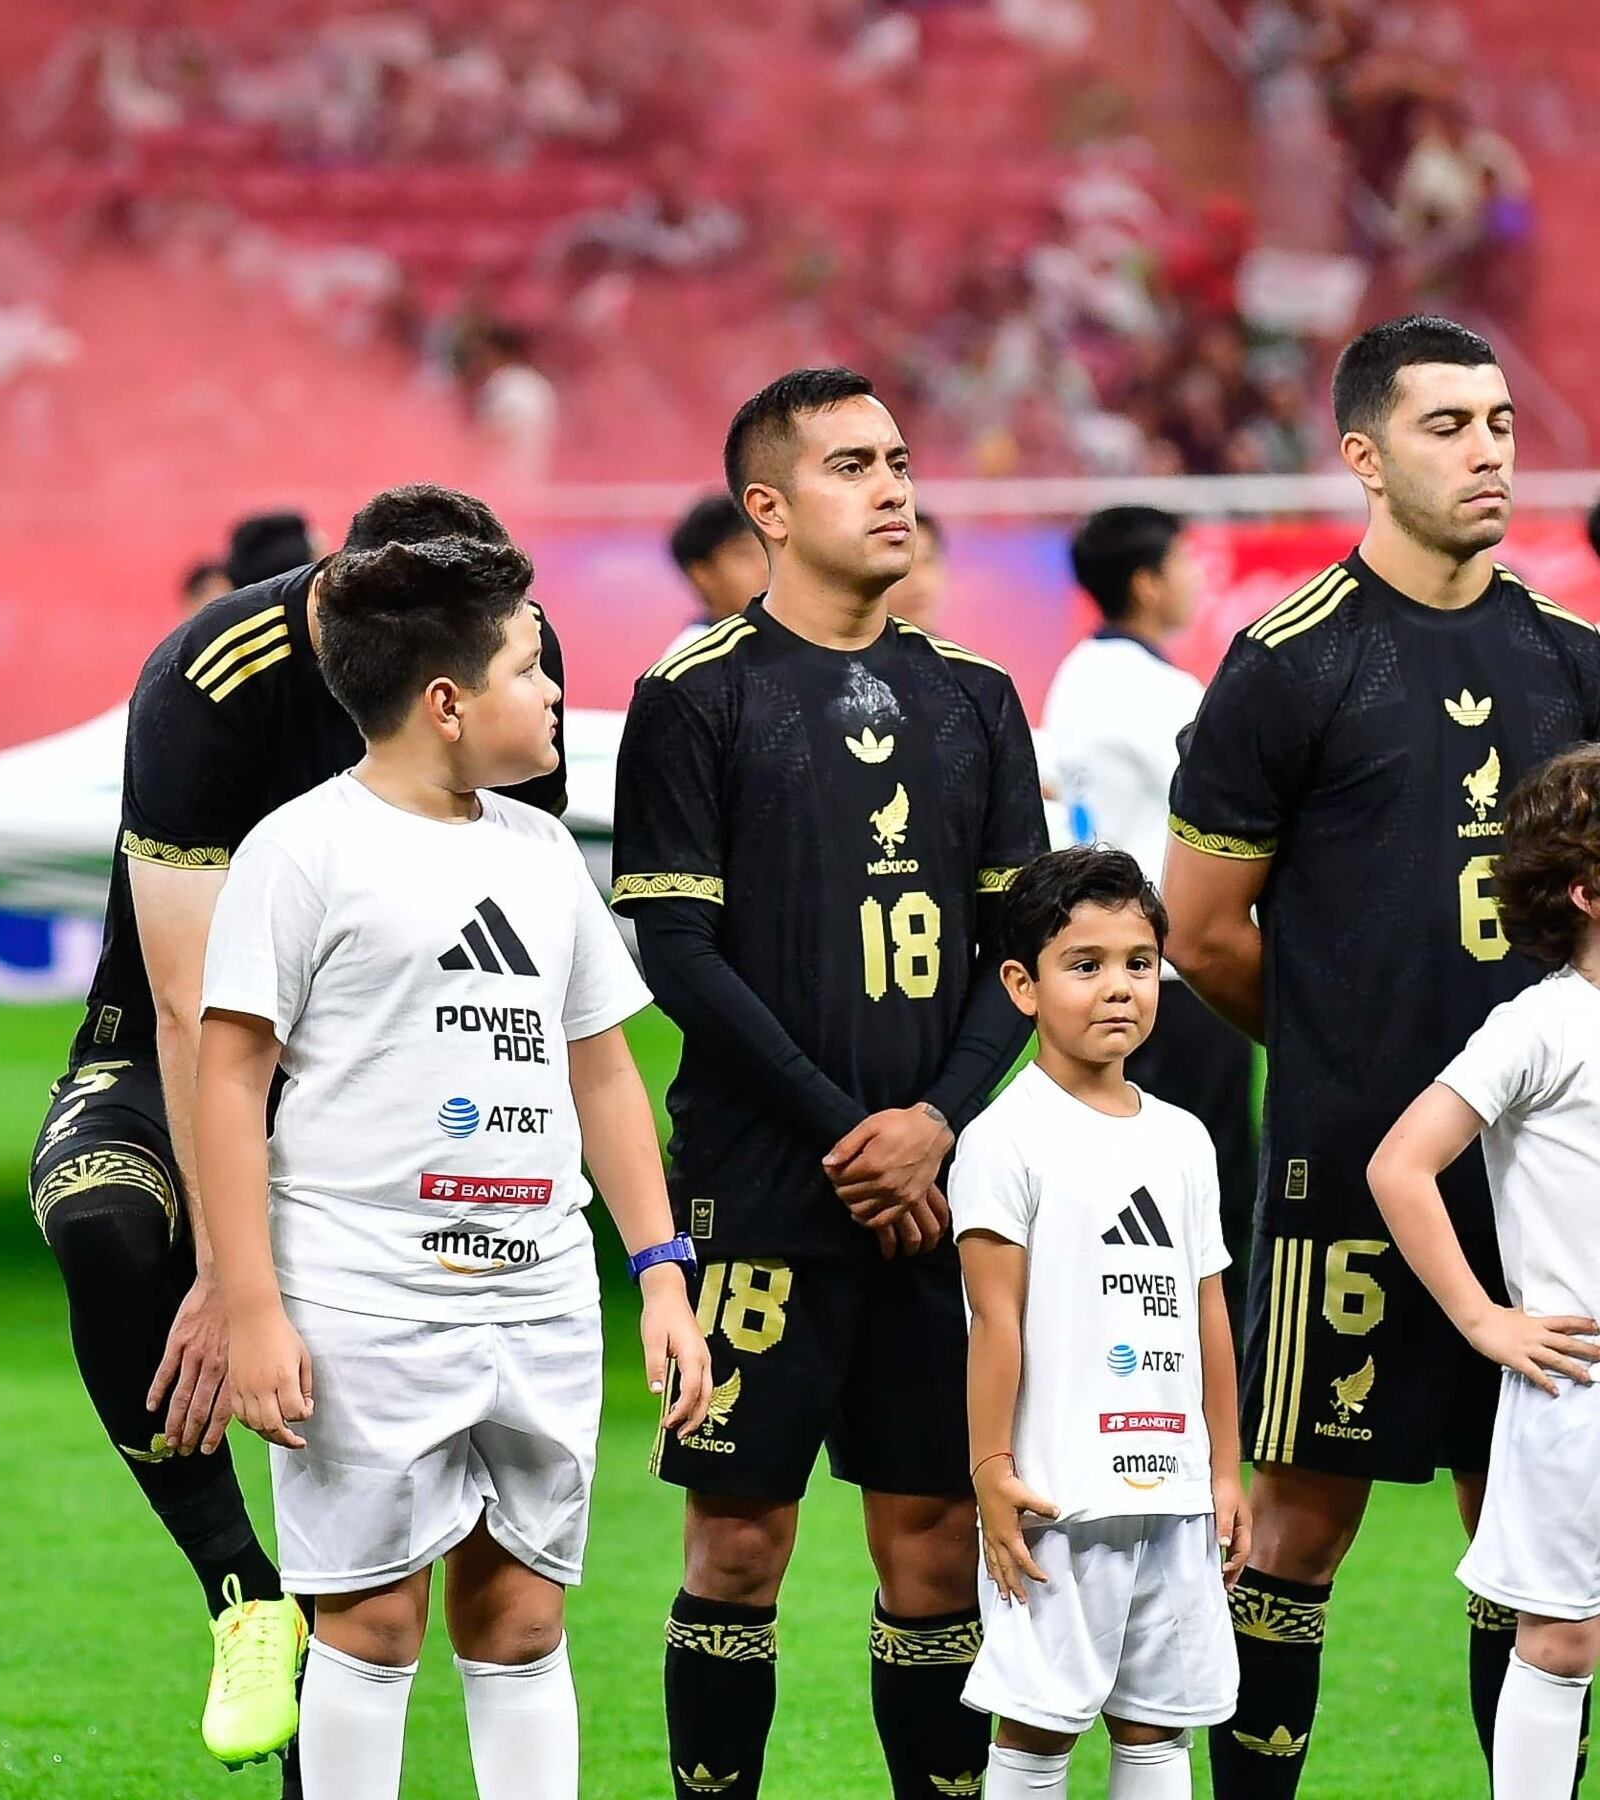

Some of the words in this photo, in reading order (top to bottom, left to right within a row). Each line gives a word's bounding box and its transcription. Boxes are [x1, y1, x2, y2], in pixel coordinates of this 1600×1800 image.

[866, 859, 920, 876] MÉXICO
[1458, 854, 1512, 962] 6
[859, 891, 942, 1002] 18
[435, 1004, 545, 1036] POWER
[485, 1105, 550, 1134] AT&T
[460, 1184, 547, 1199] BANORTE
[421, 1230, 540, 1263] amazon
[1101, 1273, 1177, 1297] POWER
[1322, 1239, 1390, 1336] 6
[695, 1258, 793, 1354] 18
[1141, 1350, 1181, 1373] AT&T
[1314, 1421, 1373, 1441] MÉXICO
[1112, 1453, 1179, 1475] amazon
